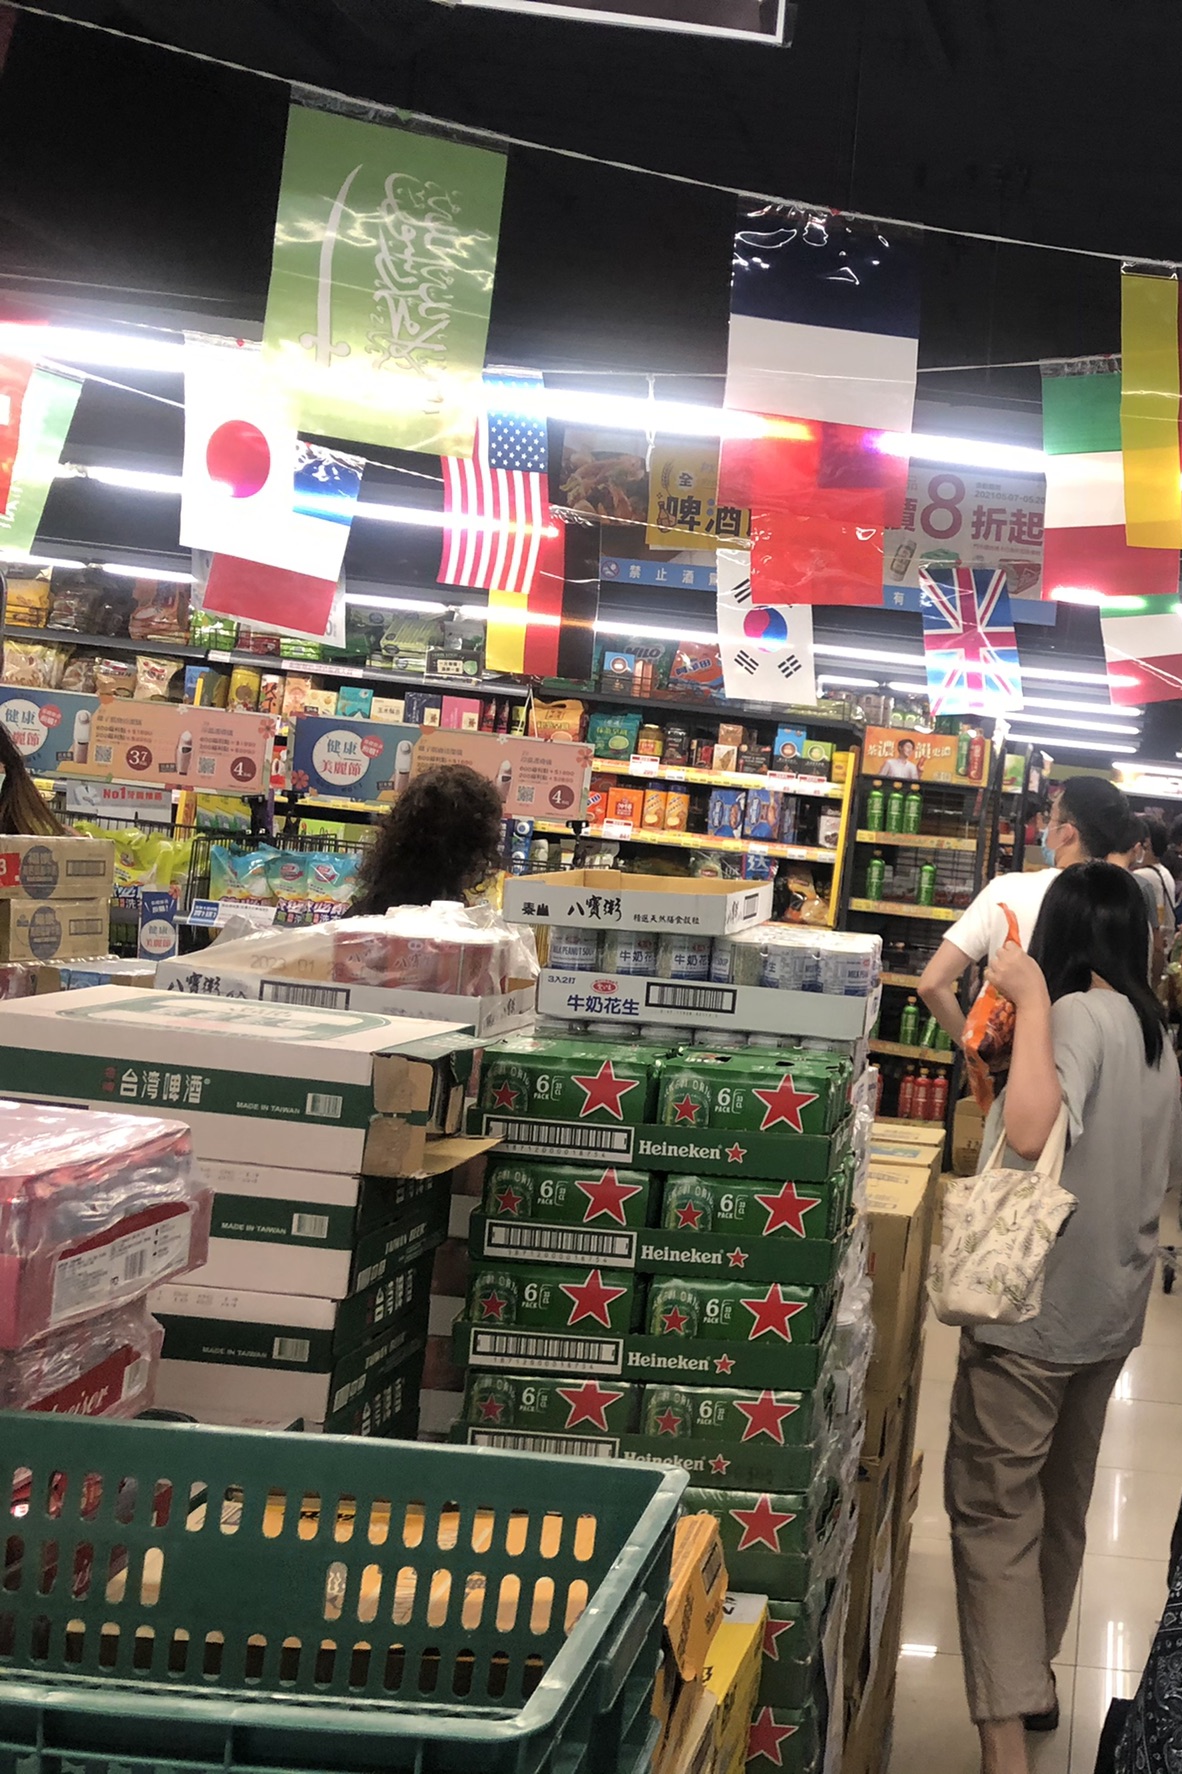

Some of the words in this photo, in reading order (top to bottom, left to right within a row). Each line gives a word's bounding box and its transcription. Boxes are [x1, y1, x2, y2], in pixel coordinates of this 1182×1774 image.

[665, 495, 751, 536] 啤酒
[625, 646, 661, 659] MILO
[4, 708, 36, 727] 健康
[11, 731, 40, 748] 麗節
[327, 739, 358, 755] 健康
[321, 759, 363, 777] 美麗節
[521, 901, 550, 917] 泰山
[567, 894, 623, 922] 八寶粥
[619, 949, 655, 963] 牛奶花
[674, 953, 710, 966] 牛奶花
[567, 994, 640, 1016] 牛奶花生
[536, 1075, 550, 1093] 6
[533, 1092, 550, 1100] PACK
[717, 1087, 731, 1106] 6
[236, 1101, 258, 1111] MADE
[270, 1105, 301, 1115] TAIWAN
[715, 1105, 731, 1113] PACK
[638, 1139, 721, 1160] Heineken
[540, 1179, 554, 1198] 6
[537, 1197, 553, 1205] PACK
[720, 1194, 734, 1212] 6
[221, 1221, 244, 1232] MADE
[256, 1224, 287, 1235] TAIWAN
[640, 1244, 722, 1264] Heineken
[524, 1283, 538, 1302] 6
[521, 1301, 538, 1309] PACK
[705, 1298, 719, 1317] 6
[627, 1351, 709, 1371] Heineken
[522, 1387, 536, 1405] 6
[699, 1400, 713, 1418] 6
